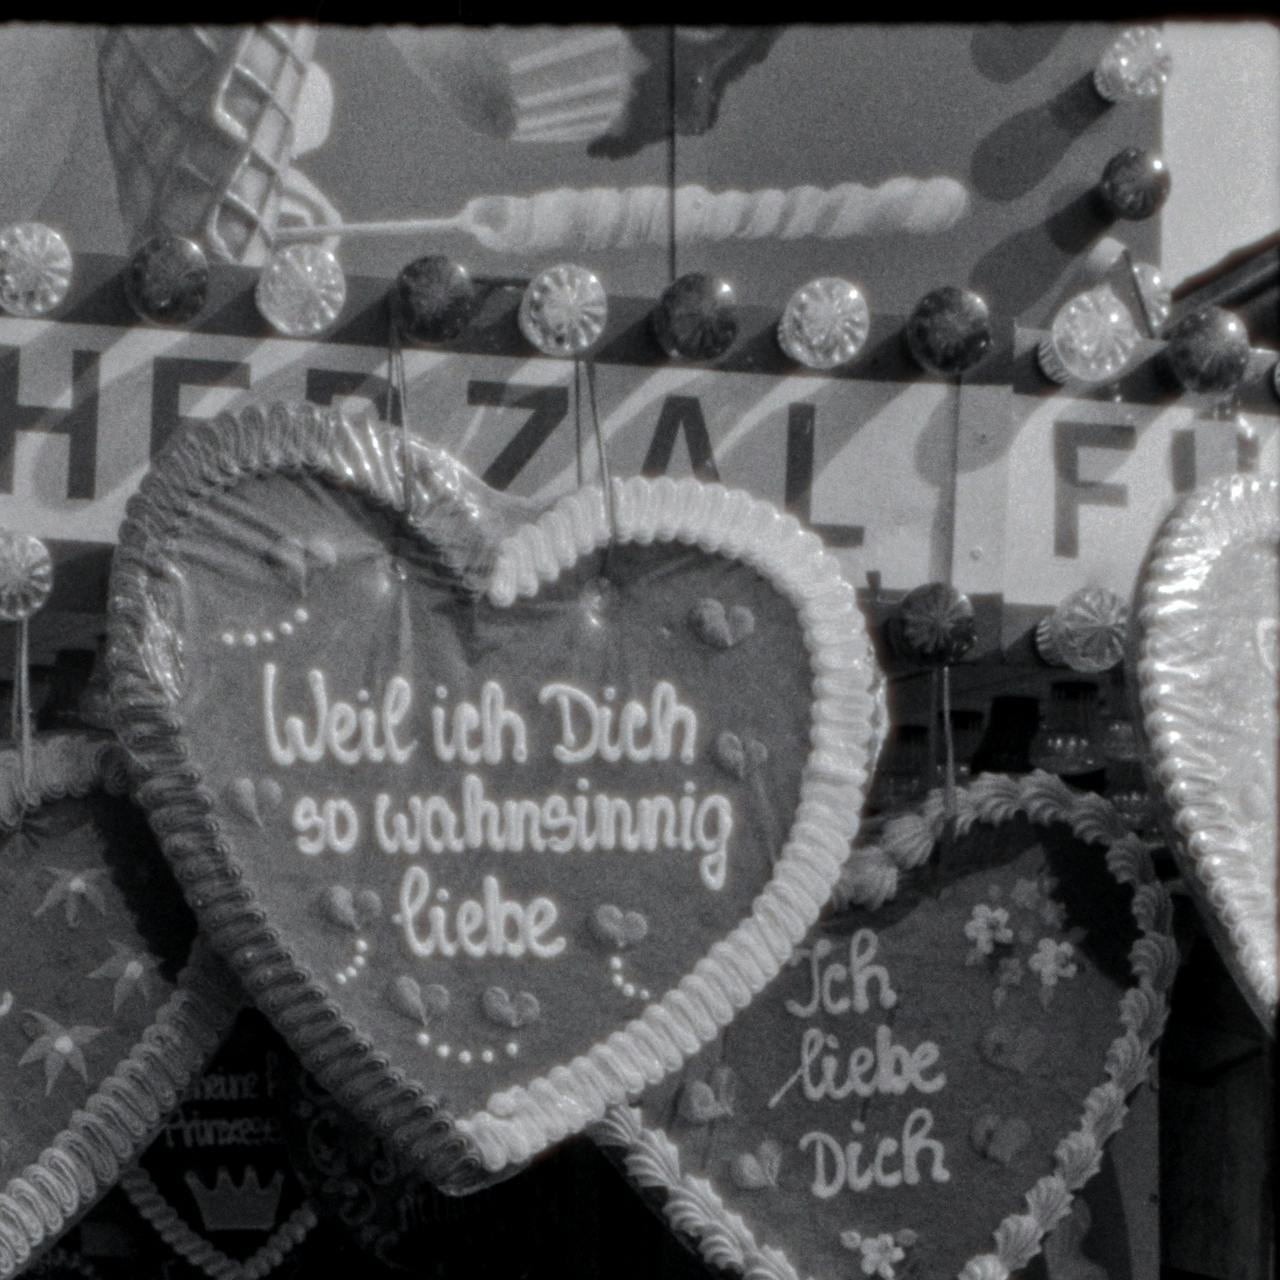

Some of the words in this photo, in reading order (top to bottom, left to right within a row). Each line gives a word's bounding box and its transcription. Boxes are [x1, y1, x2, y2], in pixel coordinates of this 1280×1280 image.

[262, 662, 417, 766] Weil
[431, 680, 529, 764] ich
[538, 680, 699, 764] Dich
[290, 795, 361, 855] so
[375, 773, 734, 891] wahnsinnig
[391, 863, 567, 959] liebe
[767, 1023, 948, 1109] liebe
[798, 1106, 951, 1199] Dich
